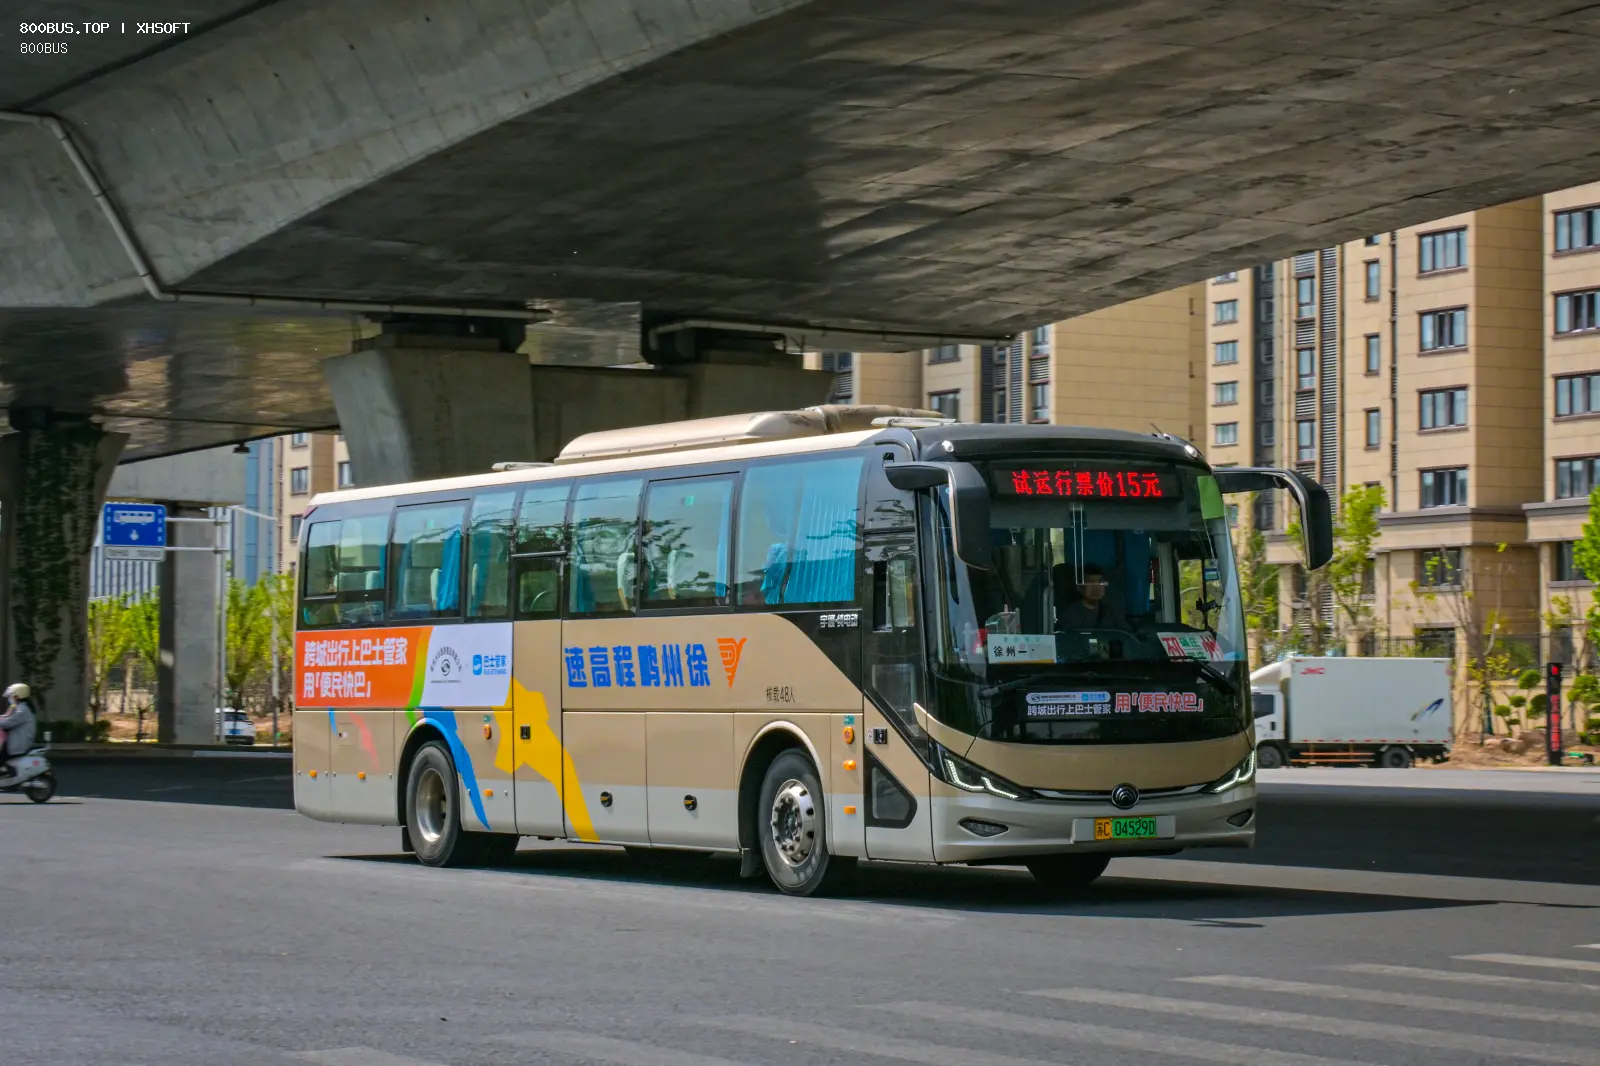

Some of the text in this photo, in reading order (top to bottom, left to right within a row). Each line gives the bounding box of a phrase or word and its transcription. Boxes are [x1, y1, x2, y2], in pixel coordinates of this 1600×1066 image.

[1011, 469, 1163, 497] 试运行票价15元
[303, 637, 408, 667] 跨城出行上巴士管家
[766, 686, 796, 703] 核载48人
[1027, 704, 1112, 716] 跨城出行上巴士管家
[1115, 819, 1156, 837] 04529D
